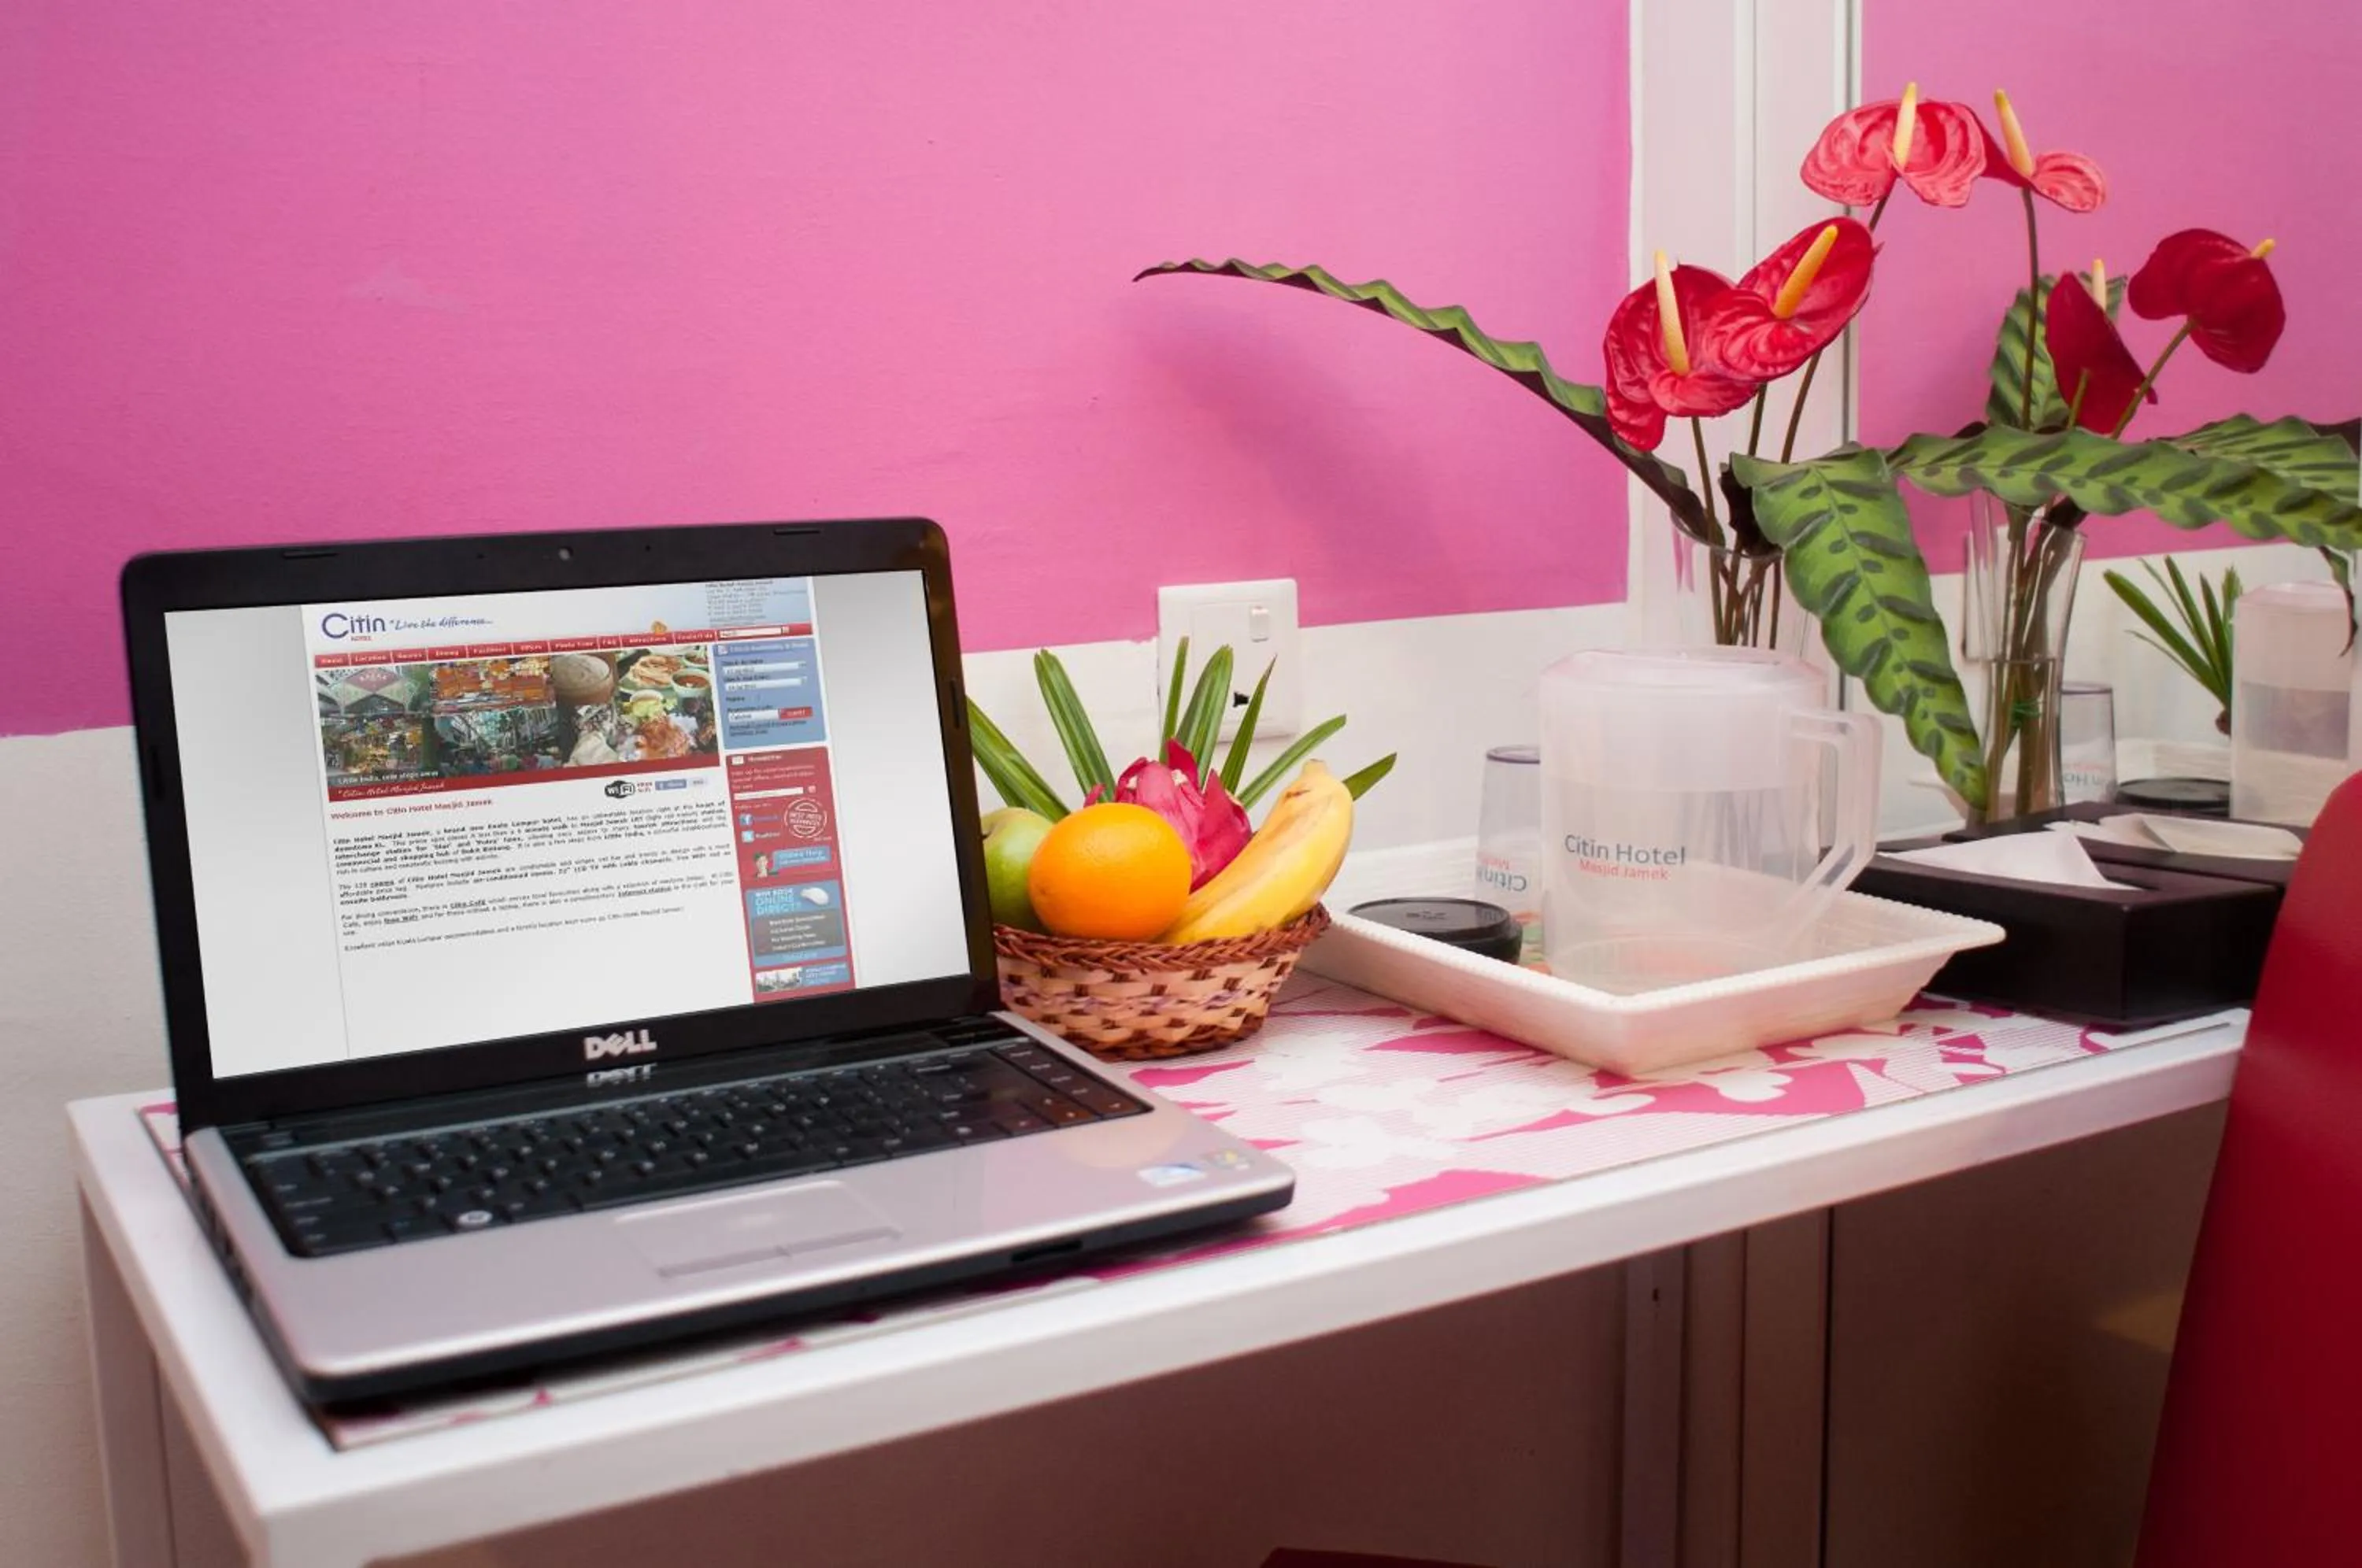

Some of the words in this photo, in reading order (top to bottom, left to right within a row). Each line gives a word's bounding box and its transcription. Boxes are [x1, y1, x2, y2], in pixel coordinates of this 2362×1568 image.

[321, 612, 386, 639] Citin
[1564, 834, 1609, 860] Citin
[1616, 843, 1686, 865] Hotel
[1579, 859, 1619, 877] Masjid
[1623, 865, 1668, 881] Jamek
[584, 1029, 657, 1060] DELL
